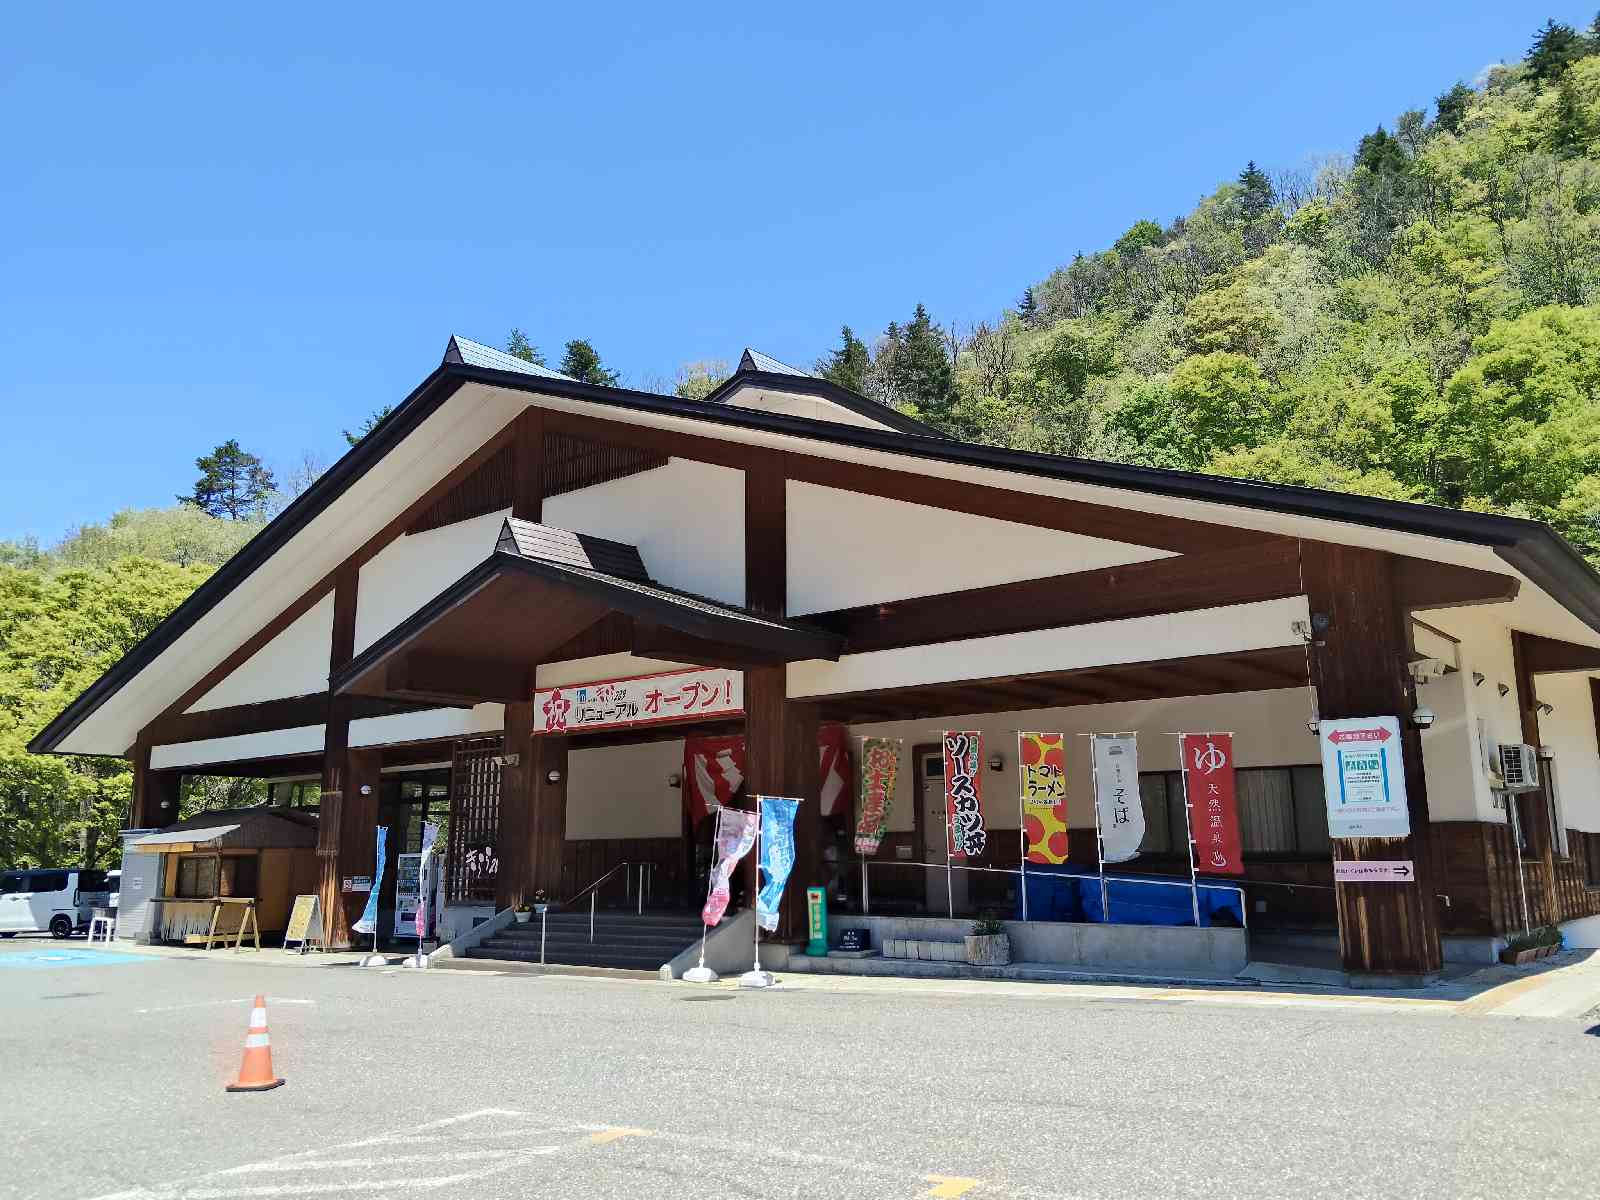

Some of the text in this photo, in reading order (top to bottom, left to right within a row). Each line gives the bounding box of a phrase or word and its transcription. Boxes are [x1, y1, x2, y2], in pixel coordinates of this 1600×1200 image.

[546, 697, 568, 732] 祝
[576, 703, 639, 723] リニューアル
[1026, 764, 1063, 778] トマト
[1193, 742, 1226, 775] ゆ
[946, 735, 986, 856] ソースカツ丼
[1027, 780, 1065, 797] ラーメン
[1113, 788, 1130, 824] そば
[1208, 783, 1222, 844] 天然温泉
